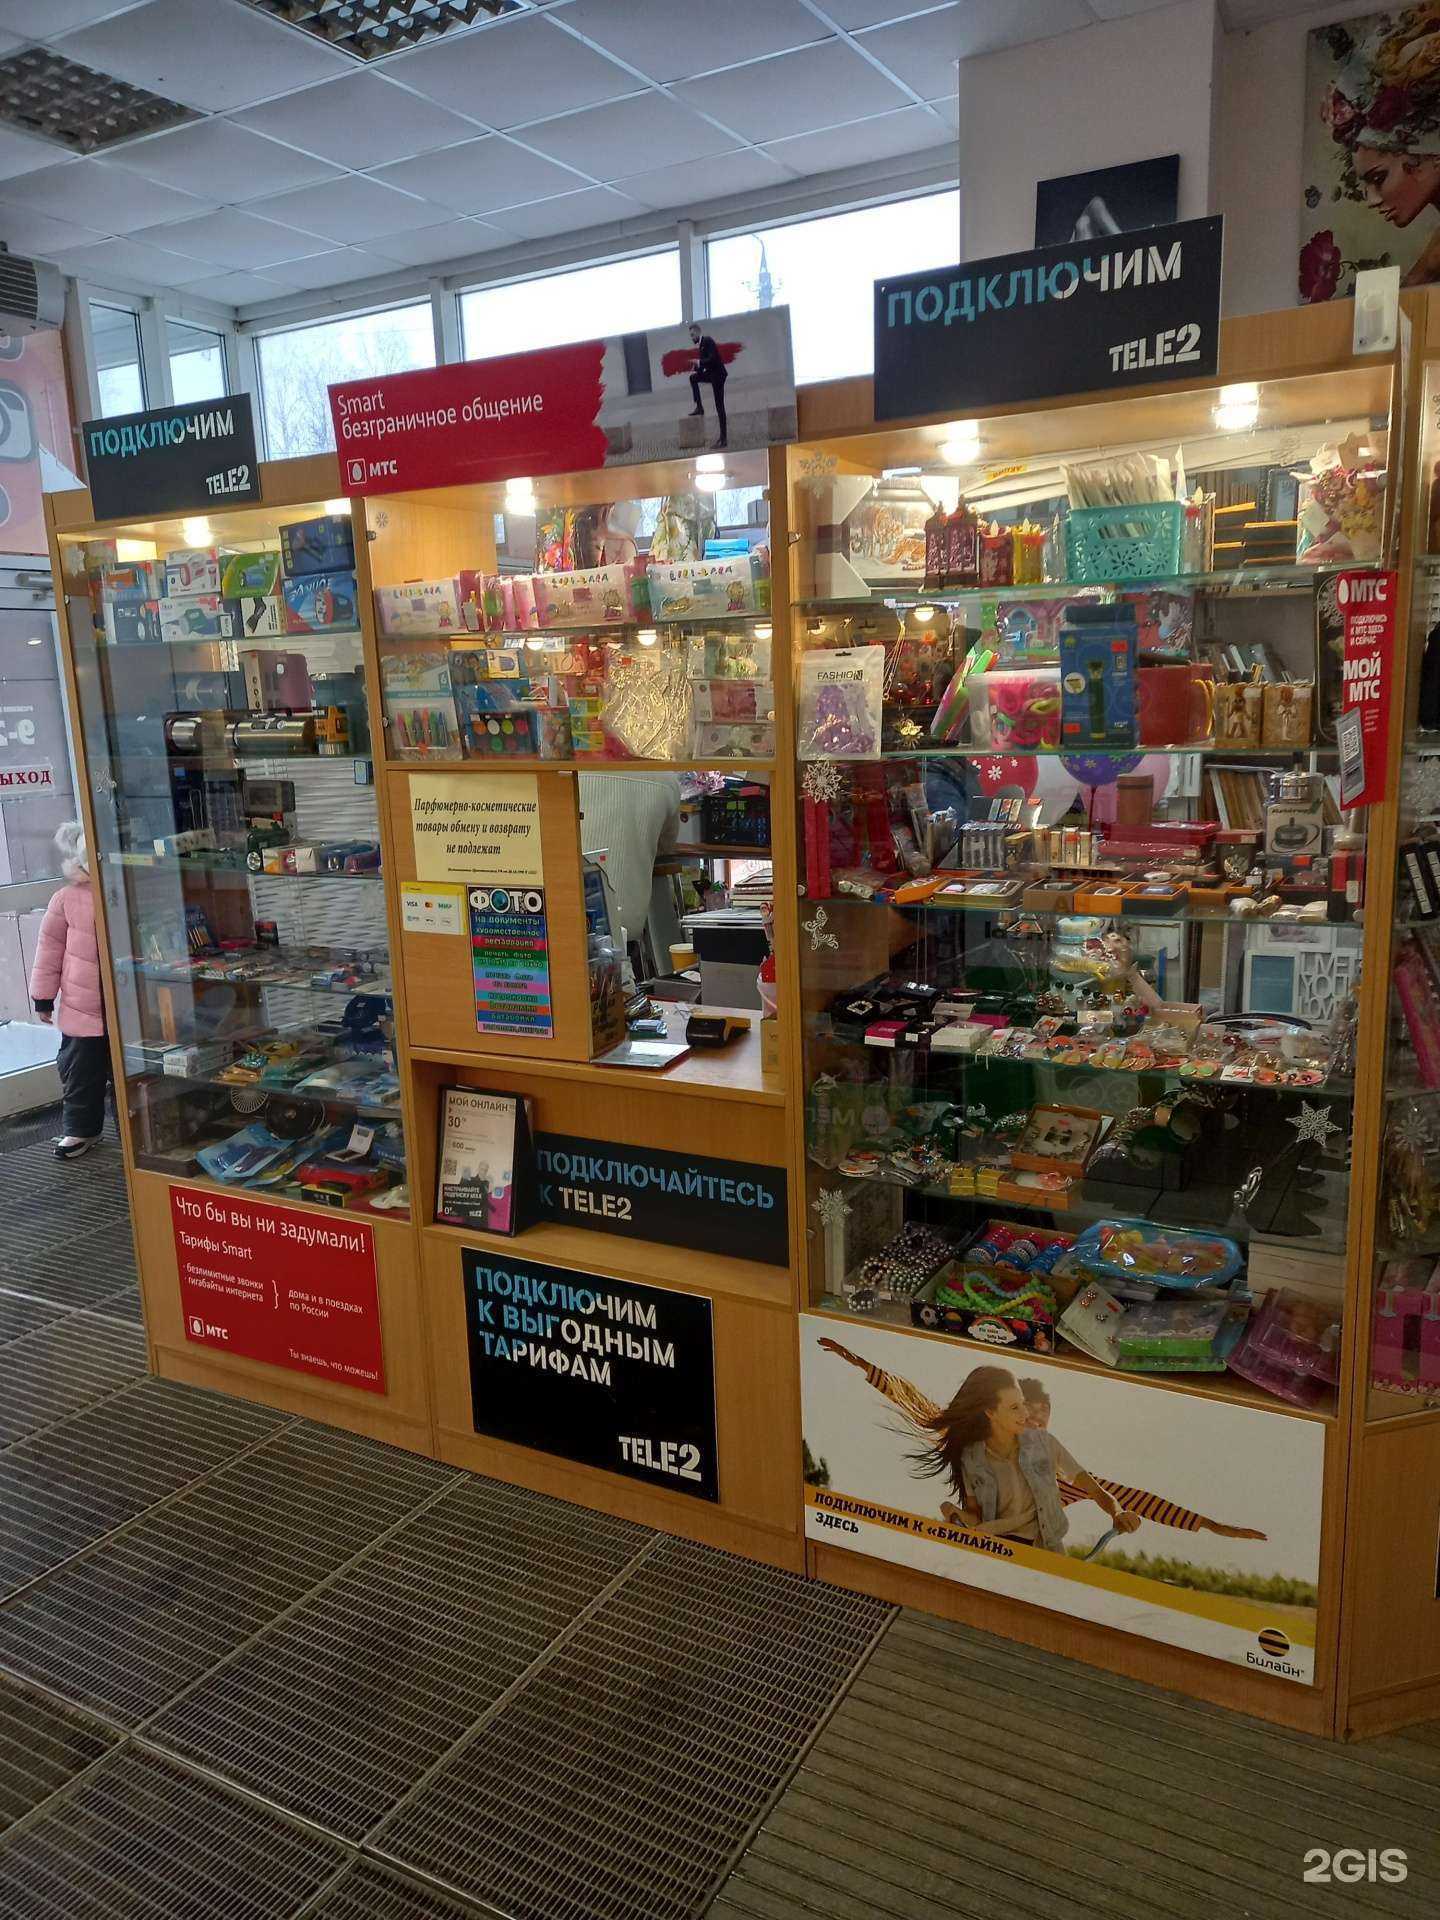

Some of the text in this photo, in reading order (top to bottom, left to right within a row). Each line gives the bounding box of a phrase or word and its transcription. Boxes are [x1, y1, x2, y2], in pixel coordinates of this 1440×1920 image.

[887, 241, 1183, 327] ПОДКЛЮЧИМ
[1109, 323, 1201, 373] TELE2
[337, 389, 385, 416] Smart
[341, 393, 543, 440] безграничное общение
[90, 409, 234, 457] ПОДКЛЮЧИМ
[205, 465, 251, 496] TELE2
[369, 460, 398, 477] МТС
[1351, 579, 1388, 602] МТС
[817, 669, 864, 681] FASHION
[1343, 651, 1381, 680] МОЙ
[1349, 680, 1381, 702] МТС
[0, 770, 52, 786] ЫХОД
[414, 798, 537, 815] Парфюмерно-косметические
[416, 820, 531, 837] товары обмену и возврату
[446, 841, 501, 855] не подлежат
[470, 888, 543, 914] ФОТО
[537, 1150, 775, 1209] ПОДКЛЮЧАЙТЕСЬ
[540, 1184, 633, 1220] К TELE2
[176, 1195, 366, 1253] Что бы вы ни задумали!
[179, 1231, 253, 1260] Тарифы Smart
[186, 1263, 264, 1290] безлимитные звонки
[188, 1277, 264, 1302] гигабайты интернета
[288, 1289, 364, 1314] дома и в поездках
[289, 1302, 329, 1319] по России
[476, 1266, 657, 1330] ПОДКЛЮЧИМ
[206, 1324, 229, 1340] МТС
[478, 1299, 676, 1368] К ВЫГОДНЫМ
[479, 1331, 612, 1386] ТАРИФАМ
[618, 1435, 702, 1482] TELE2
[814, 1492, 1014, 1557] ПОДКЛЮЧИМ К «БИЛАЙН»
[815, 1511, 860, 1534] ЗДЕСЬ
